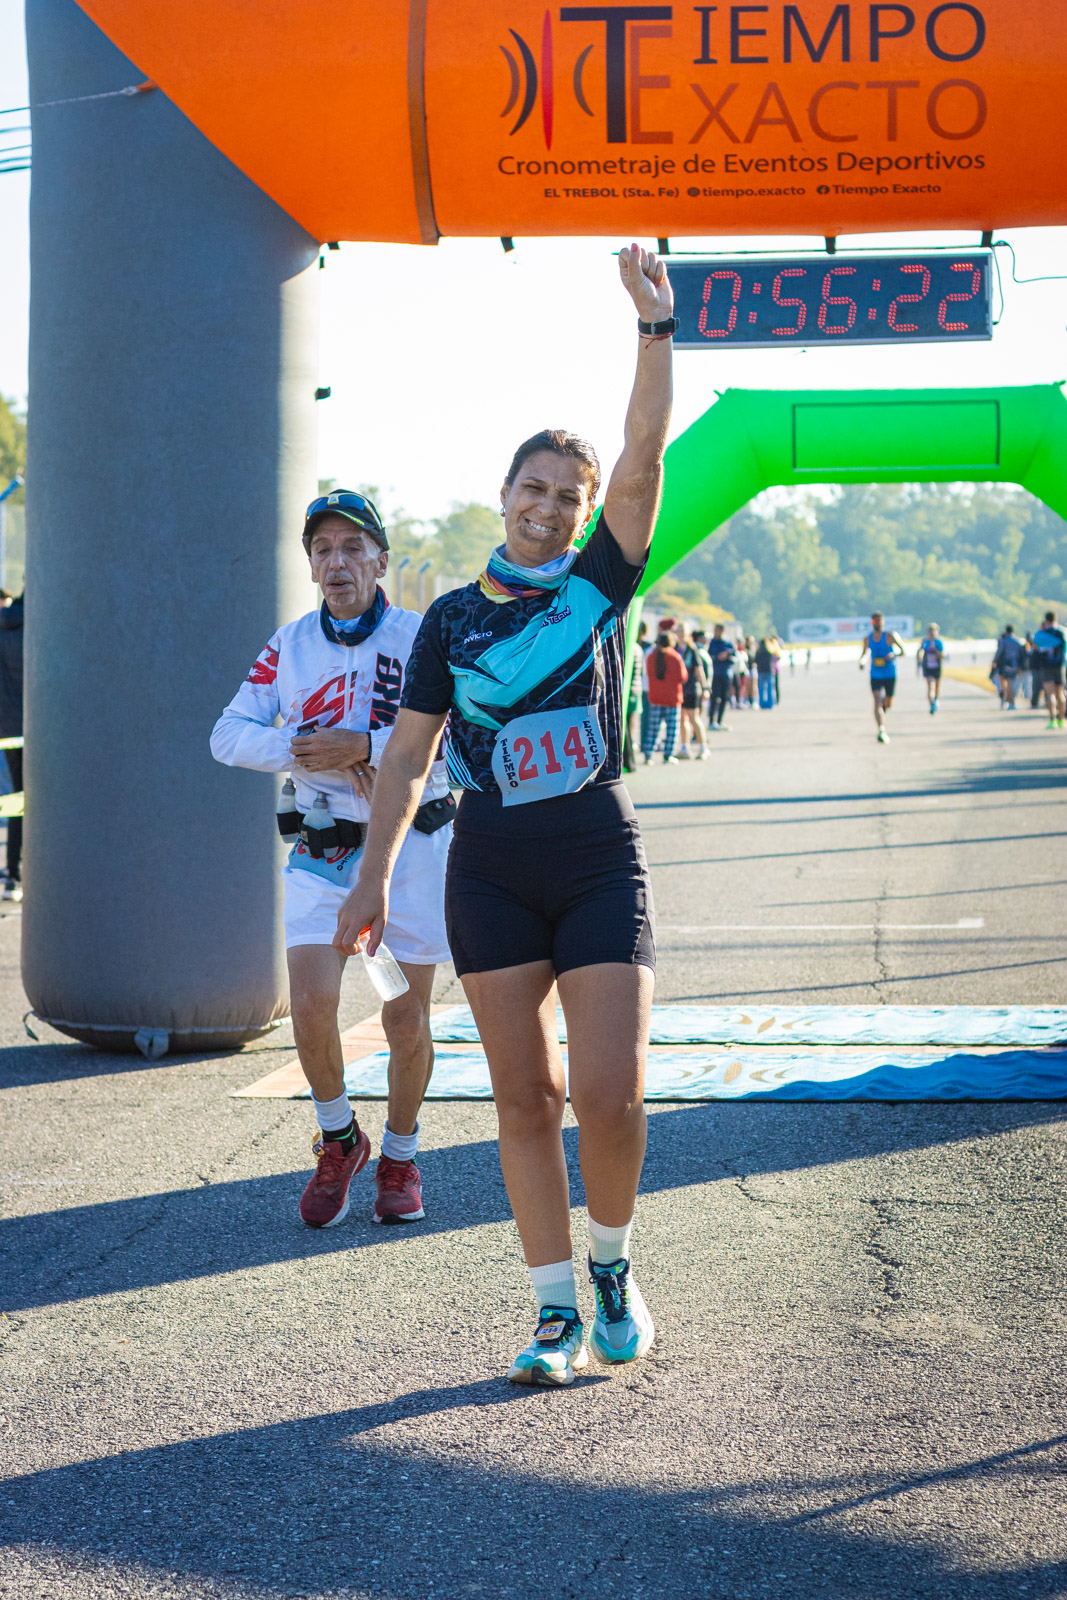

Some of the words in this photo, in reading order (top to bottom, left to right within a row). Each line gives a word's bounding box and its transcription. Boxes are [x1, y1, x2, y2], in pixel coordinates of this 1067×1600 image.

[498, 155, 676, 178] Cronometraje
[683, 154, 716, 174] de
[724, 151, 829, 173] Eventos
[837, 151, 986, 176] Deportivos
[544, 188, 561, 198] EL
[563, 188, 619, 198] TREBOL
[622, 187, 655, 199] (Sta.
[658, 187, 680, 199] Fe)
[703, 185, 806, 199] tiempo.exacto
[832, 184, 889, 196] Tiempo
[893, 184, 942, 194] Exacto
[698, 263, 981, 338] 0:56:22
[500, 738, 519, 788] TIEMPO
[513, 726, 589, 781] 214
[583, 720, 600, 770] EXACTO
